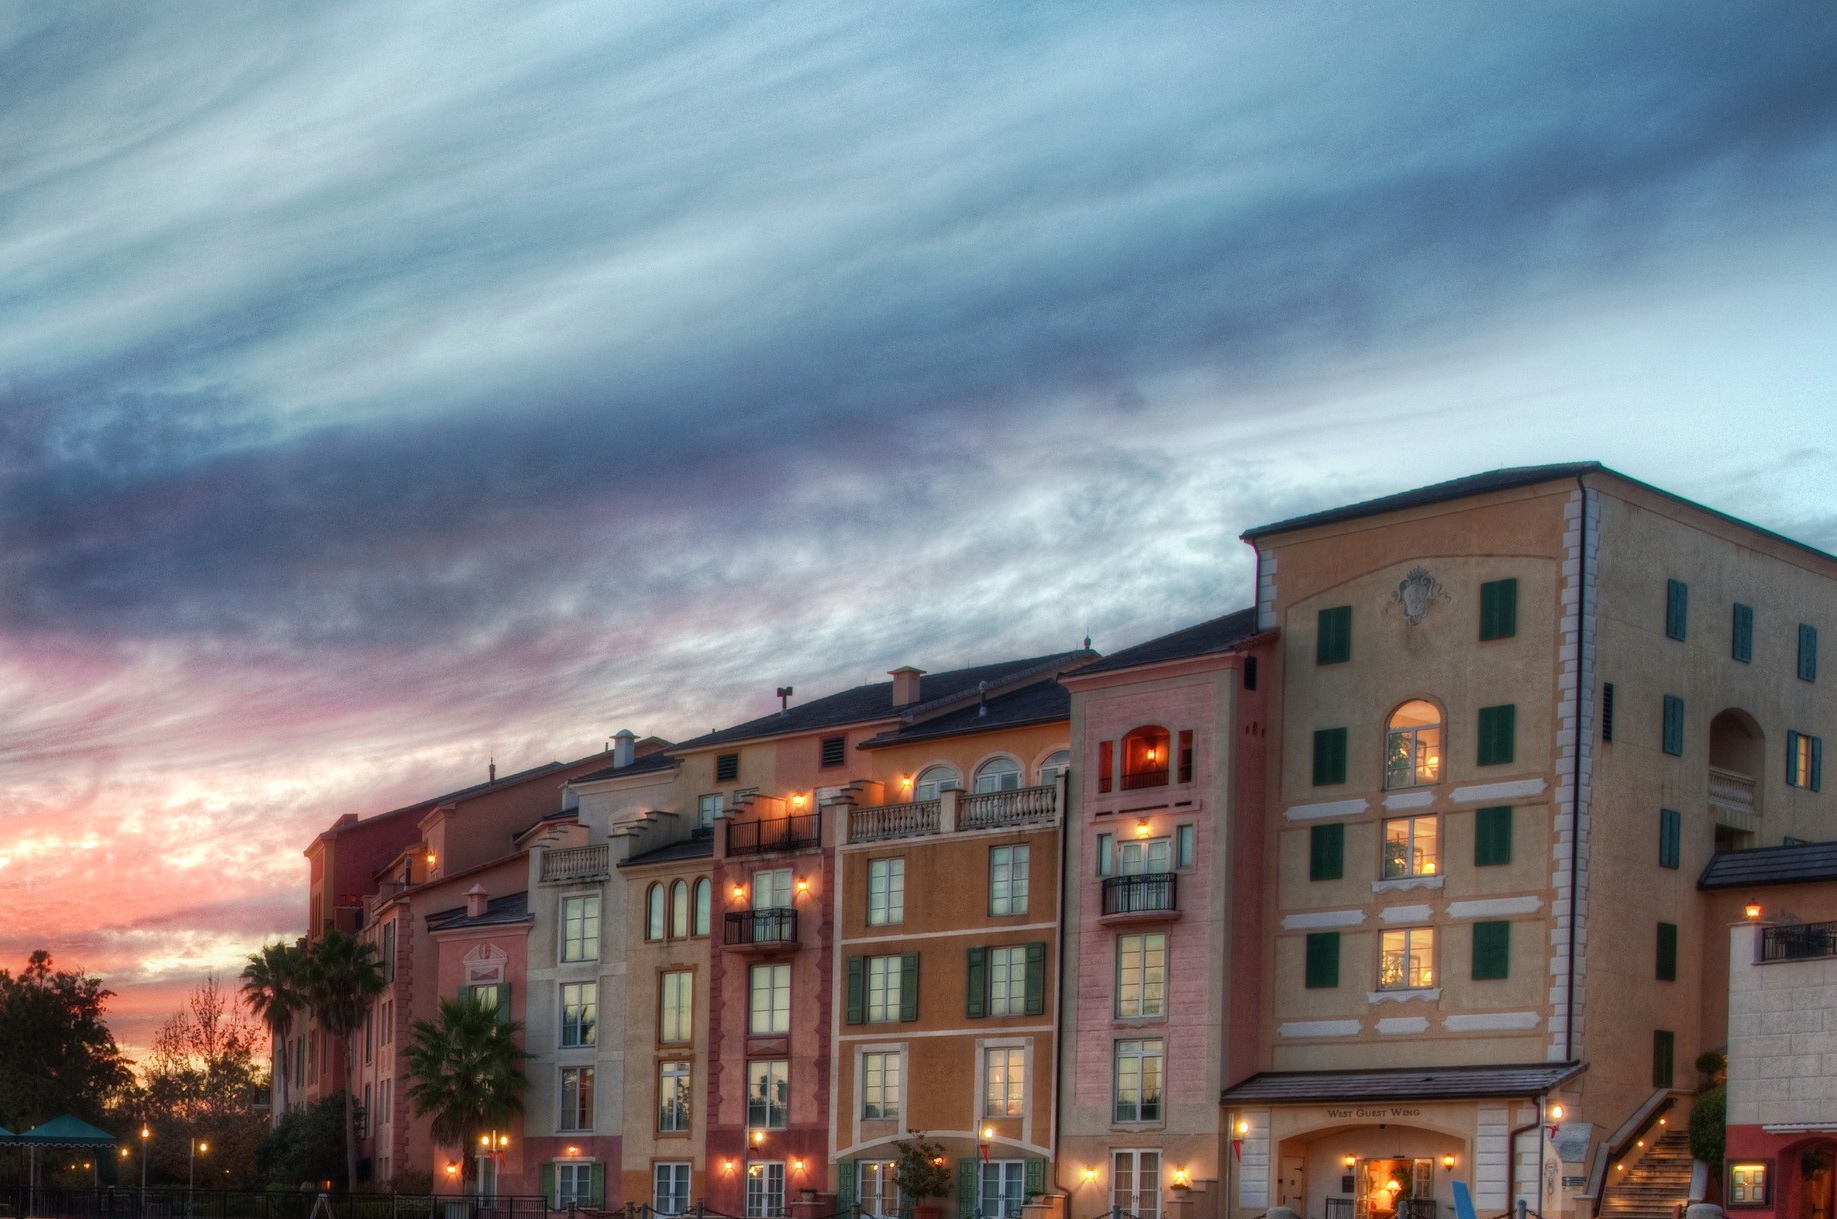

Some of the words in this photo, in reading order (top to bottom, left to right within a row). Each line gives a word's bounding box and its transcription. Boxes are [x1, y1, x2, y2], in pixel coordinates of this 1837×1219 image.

[1327, 1109, 1353, 1118] WEST
[1356, 1108, 1387, 1118] GUEST
[1390, 1107, 1421, 1117] WING
